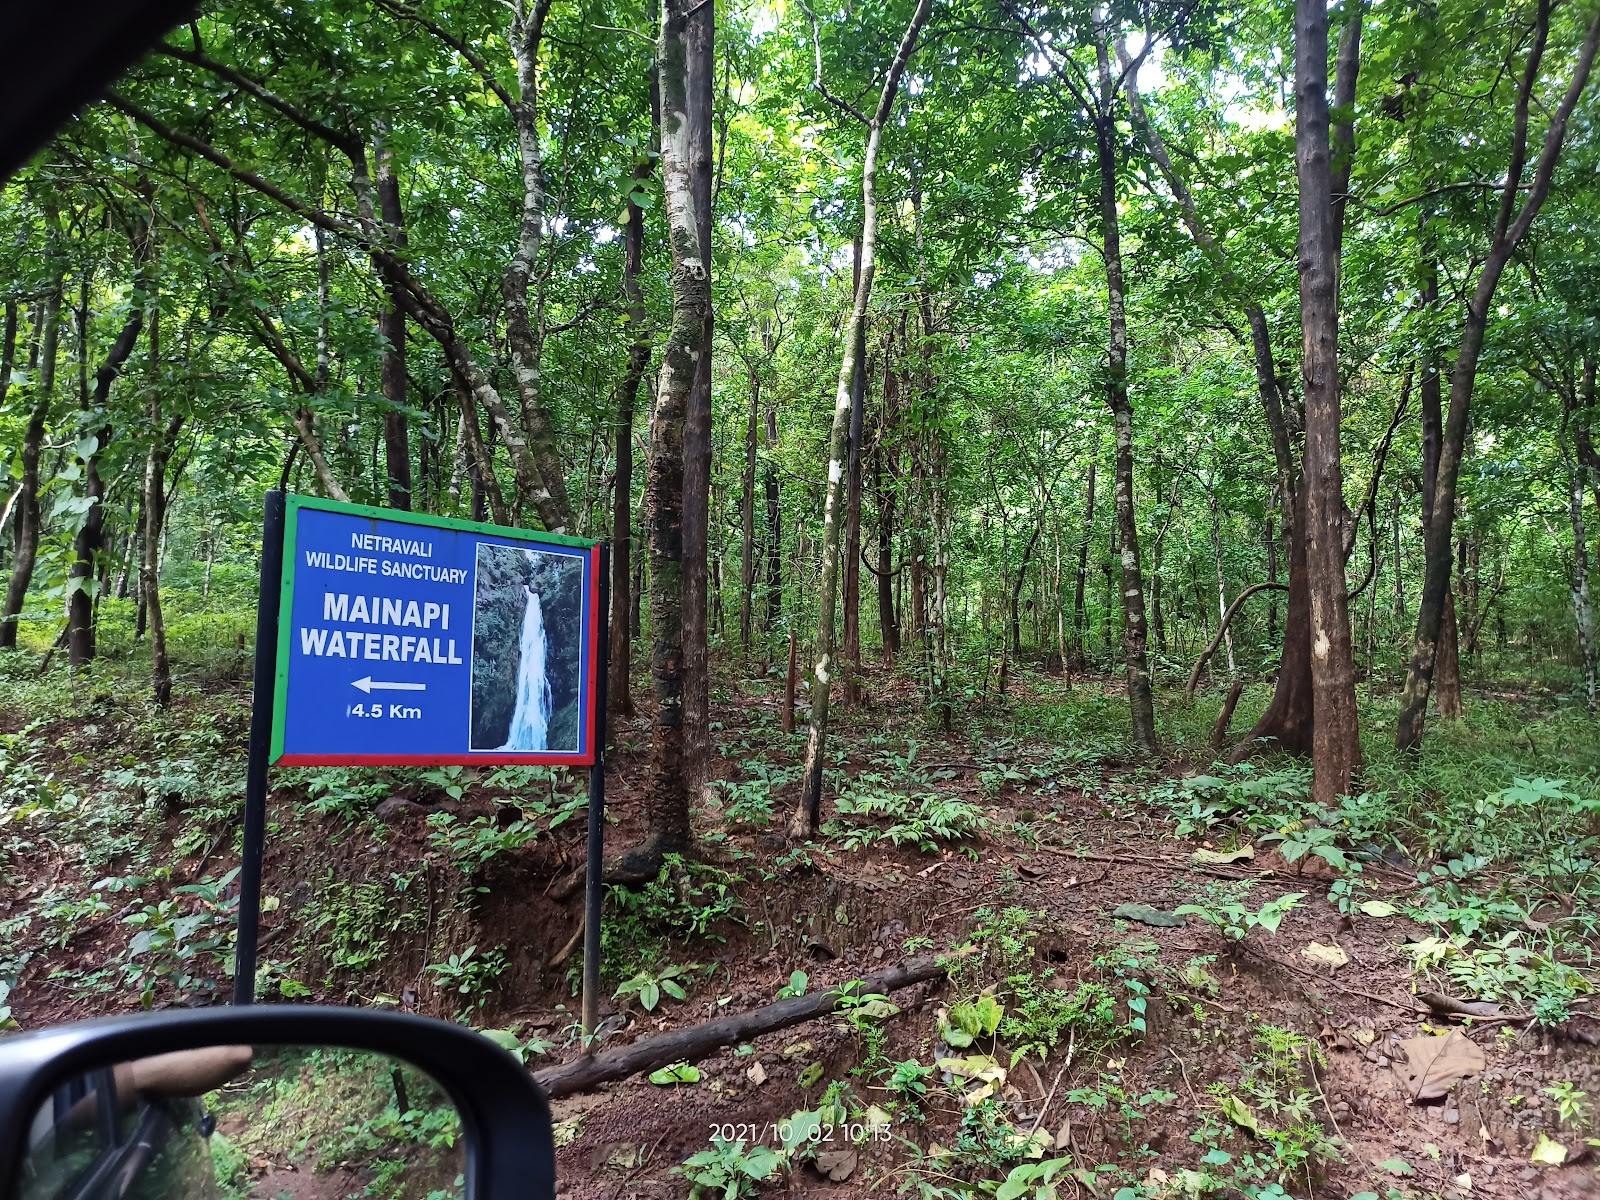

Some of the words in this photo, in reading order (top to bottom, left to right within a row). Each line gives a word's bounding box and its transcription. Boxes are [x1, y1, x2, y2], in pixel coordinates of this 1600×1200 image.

[351, 532, 432, 558] NETRAVALI
[305, 551, 378, 575] WILDLIFE
[381, 560, 469, 585] SANCTUARY
[323, 592, 450, 631] MAINAPI
[300, 627, 463, 665] WATERFALL
[389, 704, 422, 720] Km
